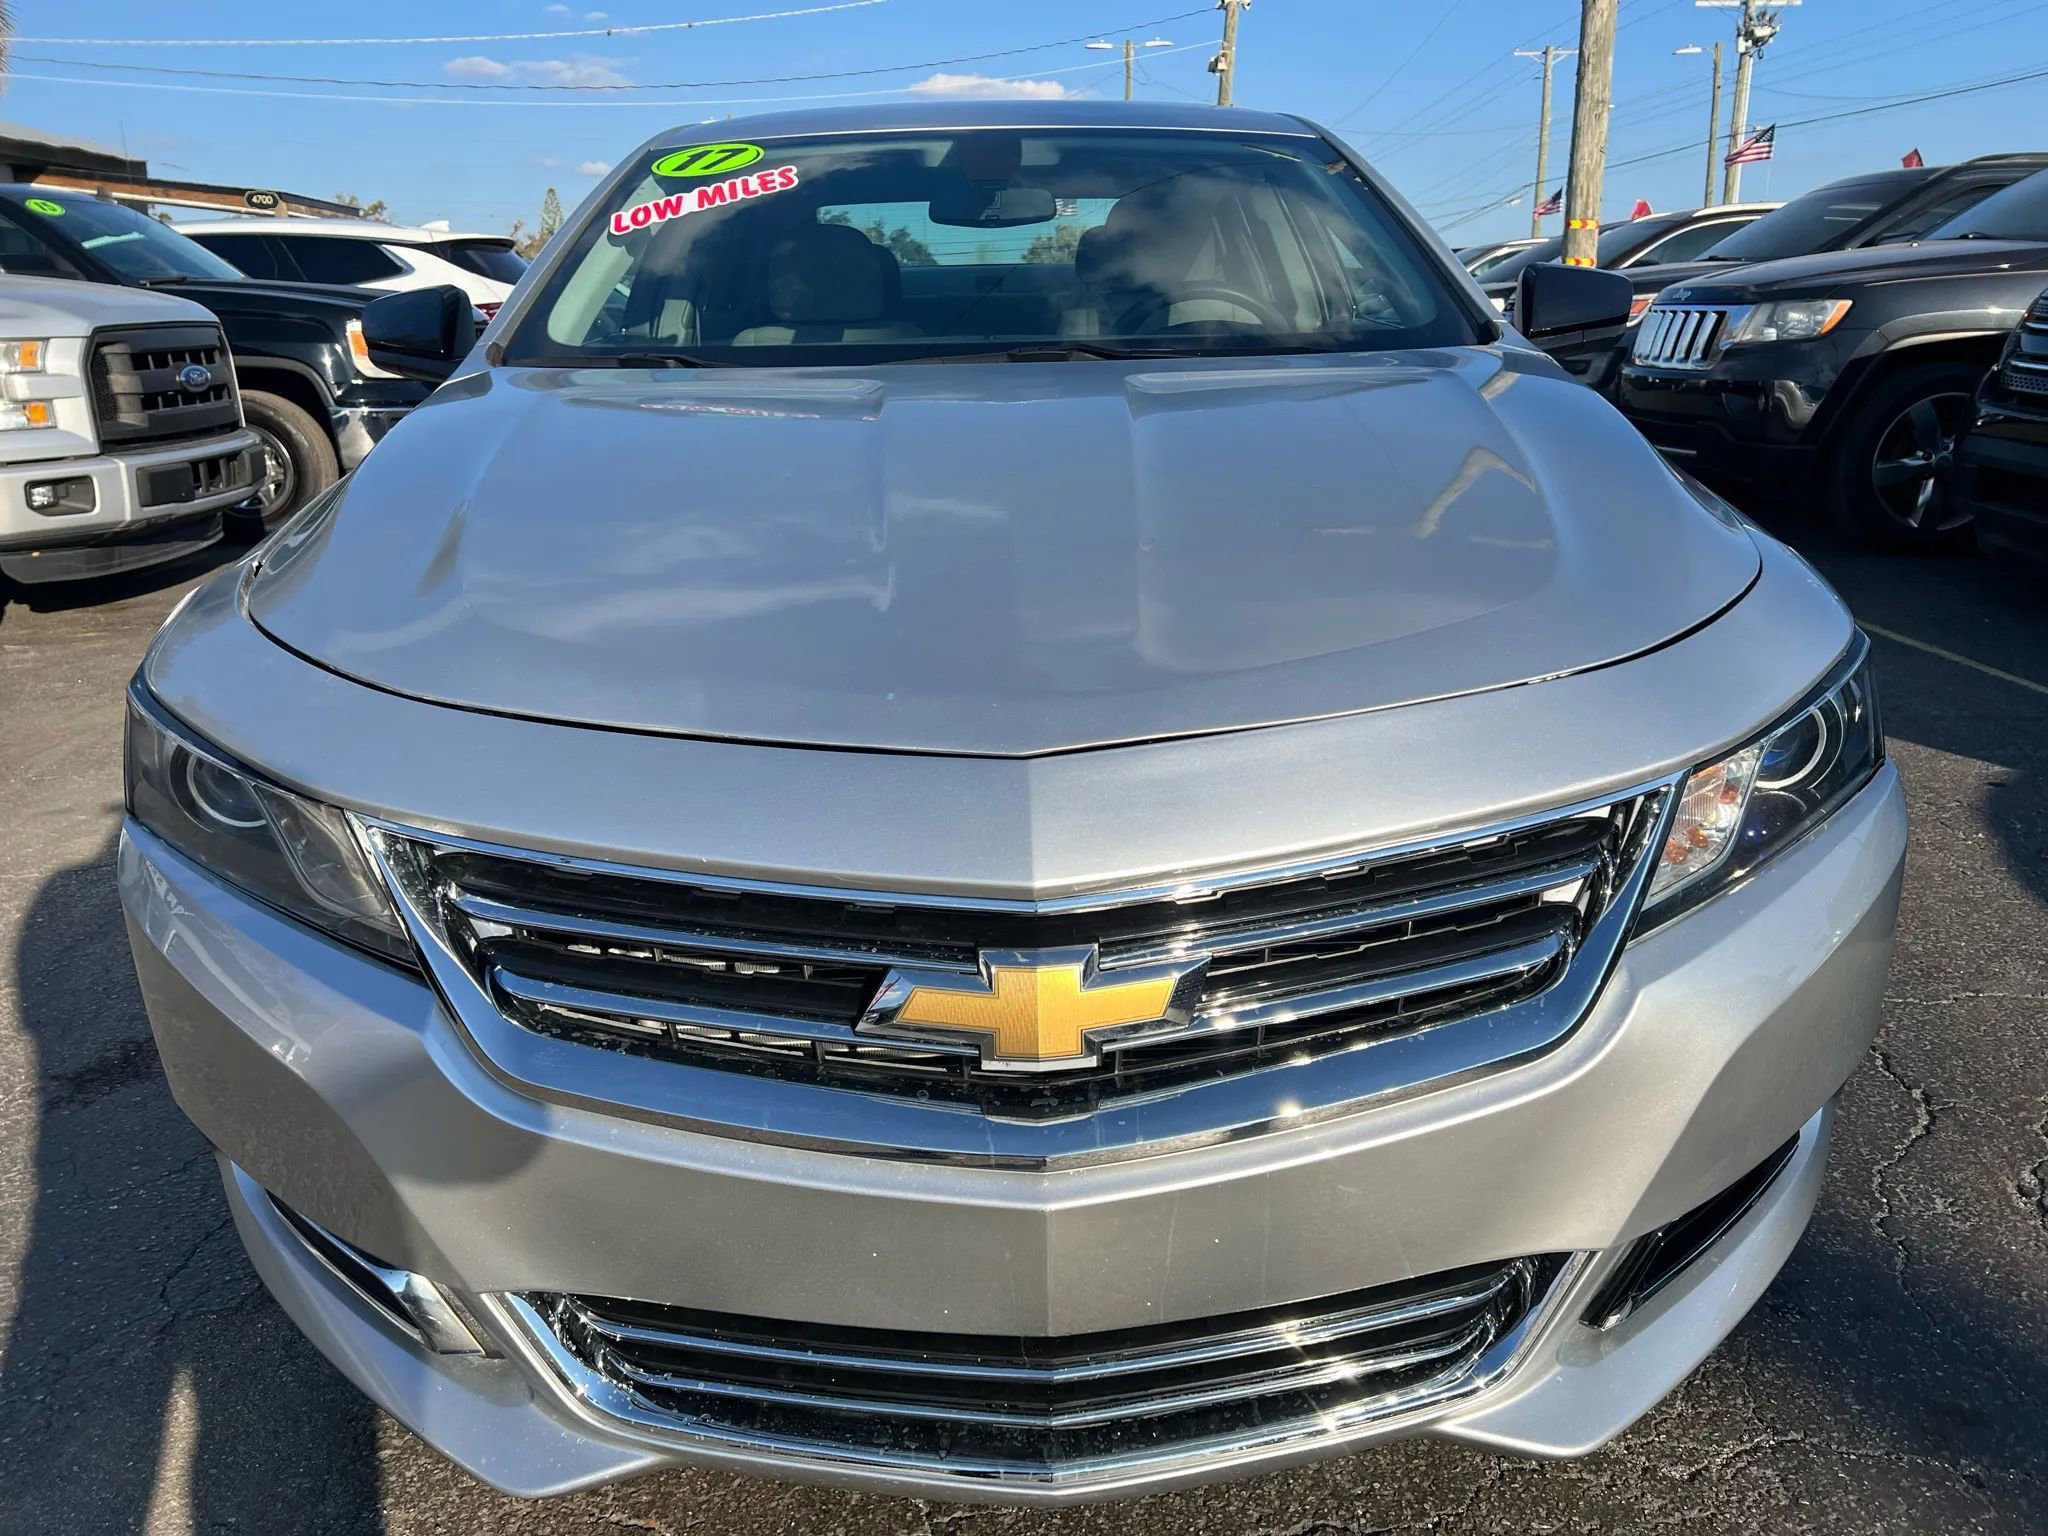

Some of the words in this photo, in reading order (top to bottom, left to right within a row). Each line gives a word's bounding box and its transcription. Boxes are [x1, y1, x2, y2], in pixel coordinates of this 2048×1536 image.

[671, 147, 749, 172] 17
[612, 195, 683, 233] LOW
[697, 166, 797, 209] MILES
